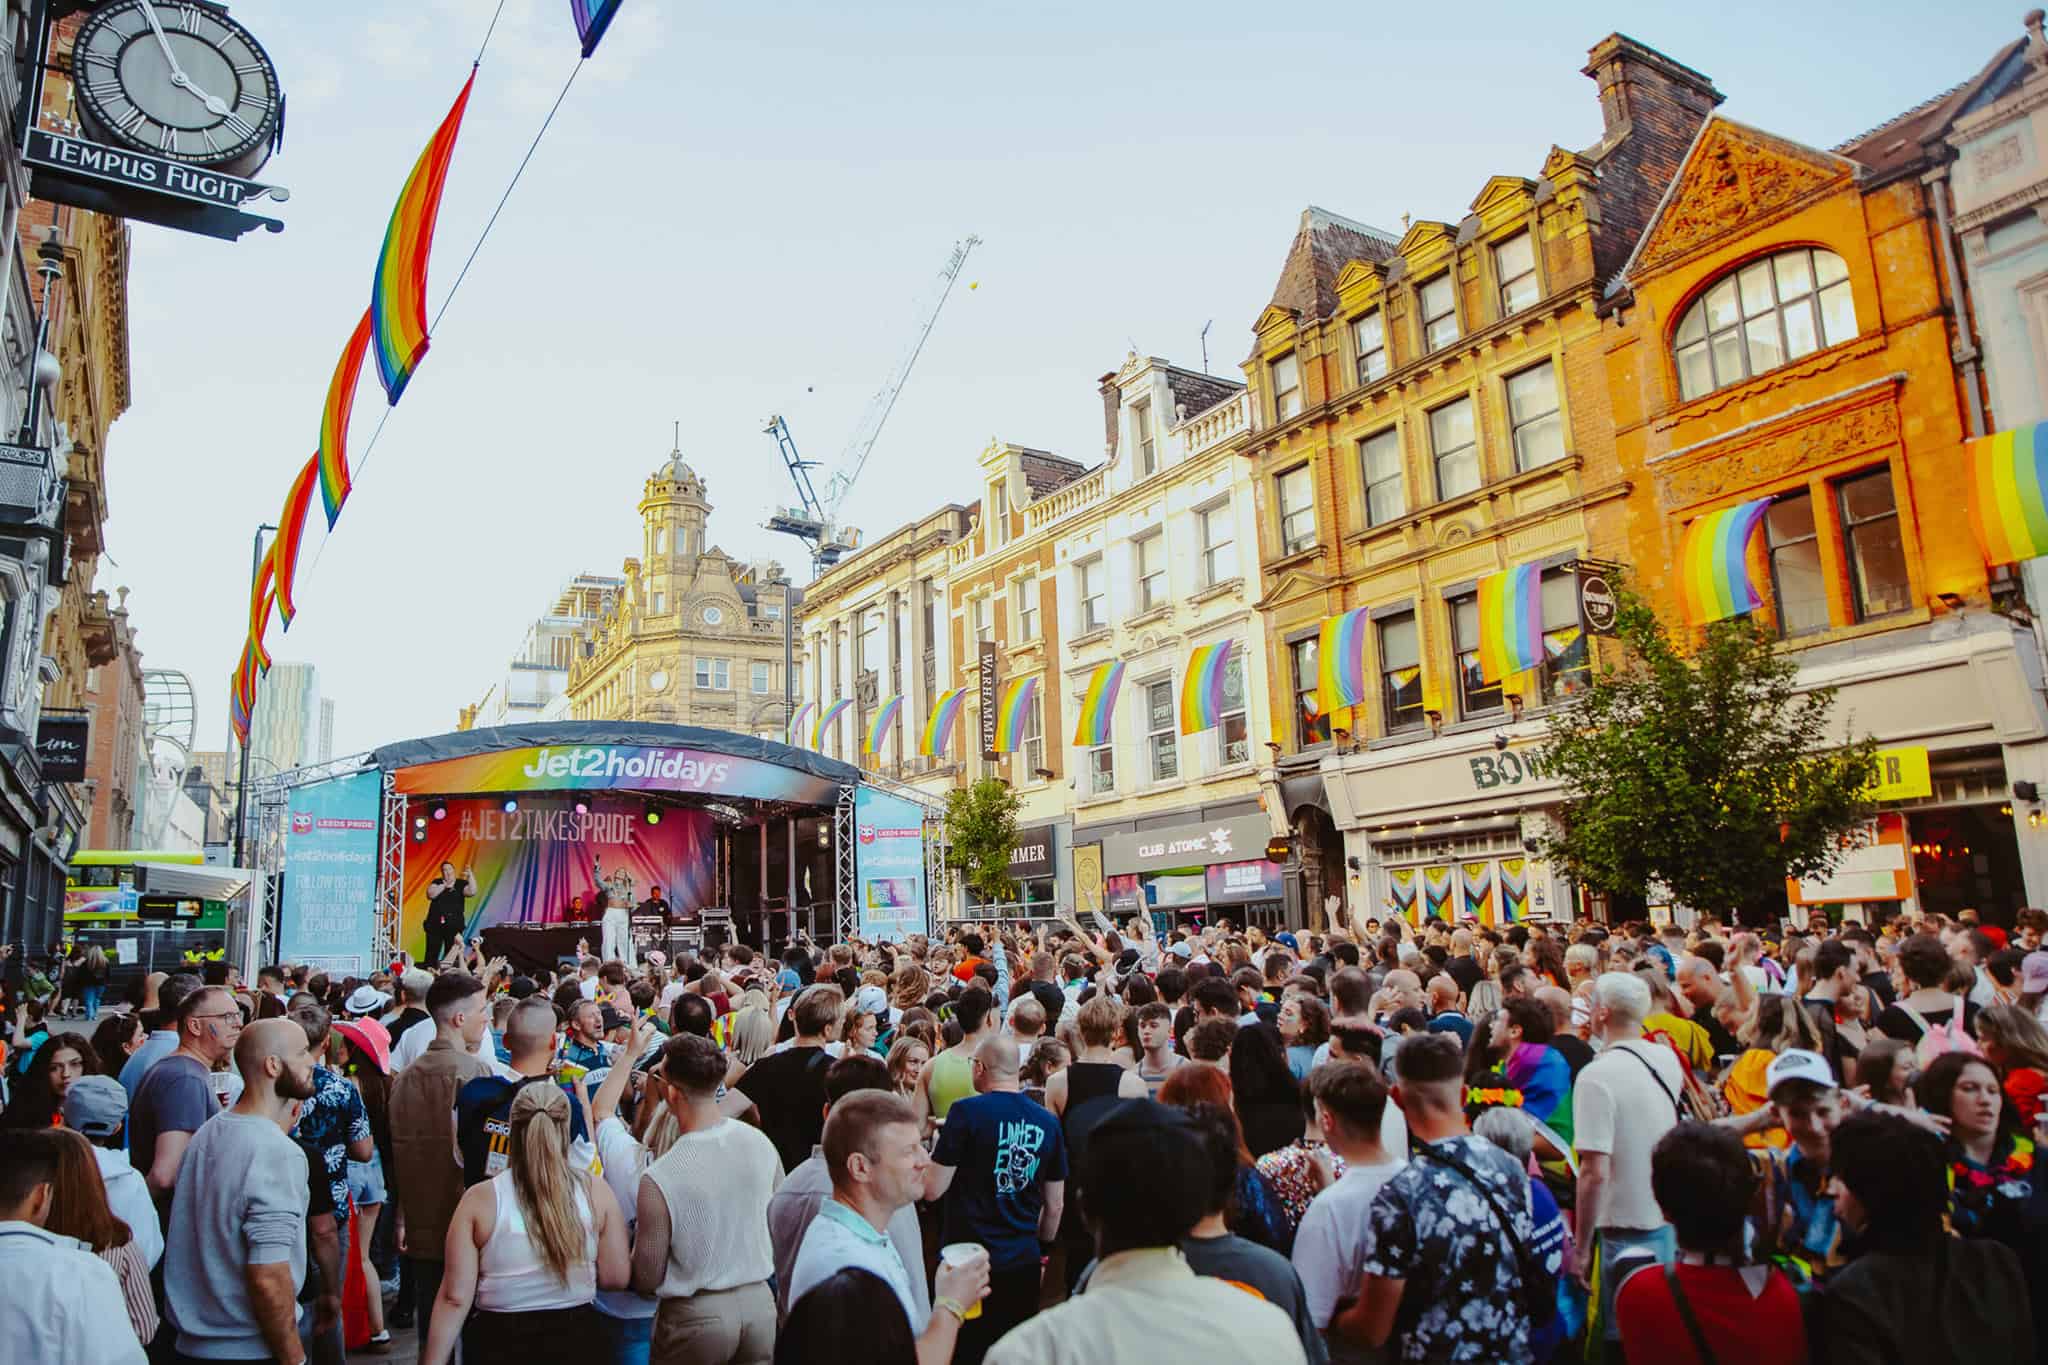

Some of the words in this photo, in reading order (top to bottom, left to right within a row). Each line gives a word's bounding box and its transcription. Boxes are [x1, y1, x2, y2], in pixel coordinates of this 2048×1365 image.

[44, 134, 157, 183] TEMPUS
[165, 164, 246, 204] FUGIT
[981, 654, 994, 752] WARHAMMER
[523, 748, 729, 787] Jet2holidays
[459, 809, 636, 844] #JET2TAKESPRIDE
[1139, 843, 1165, 857] CLUB
